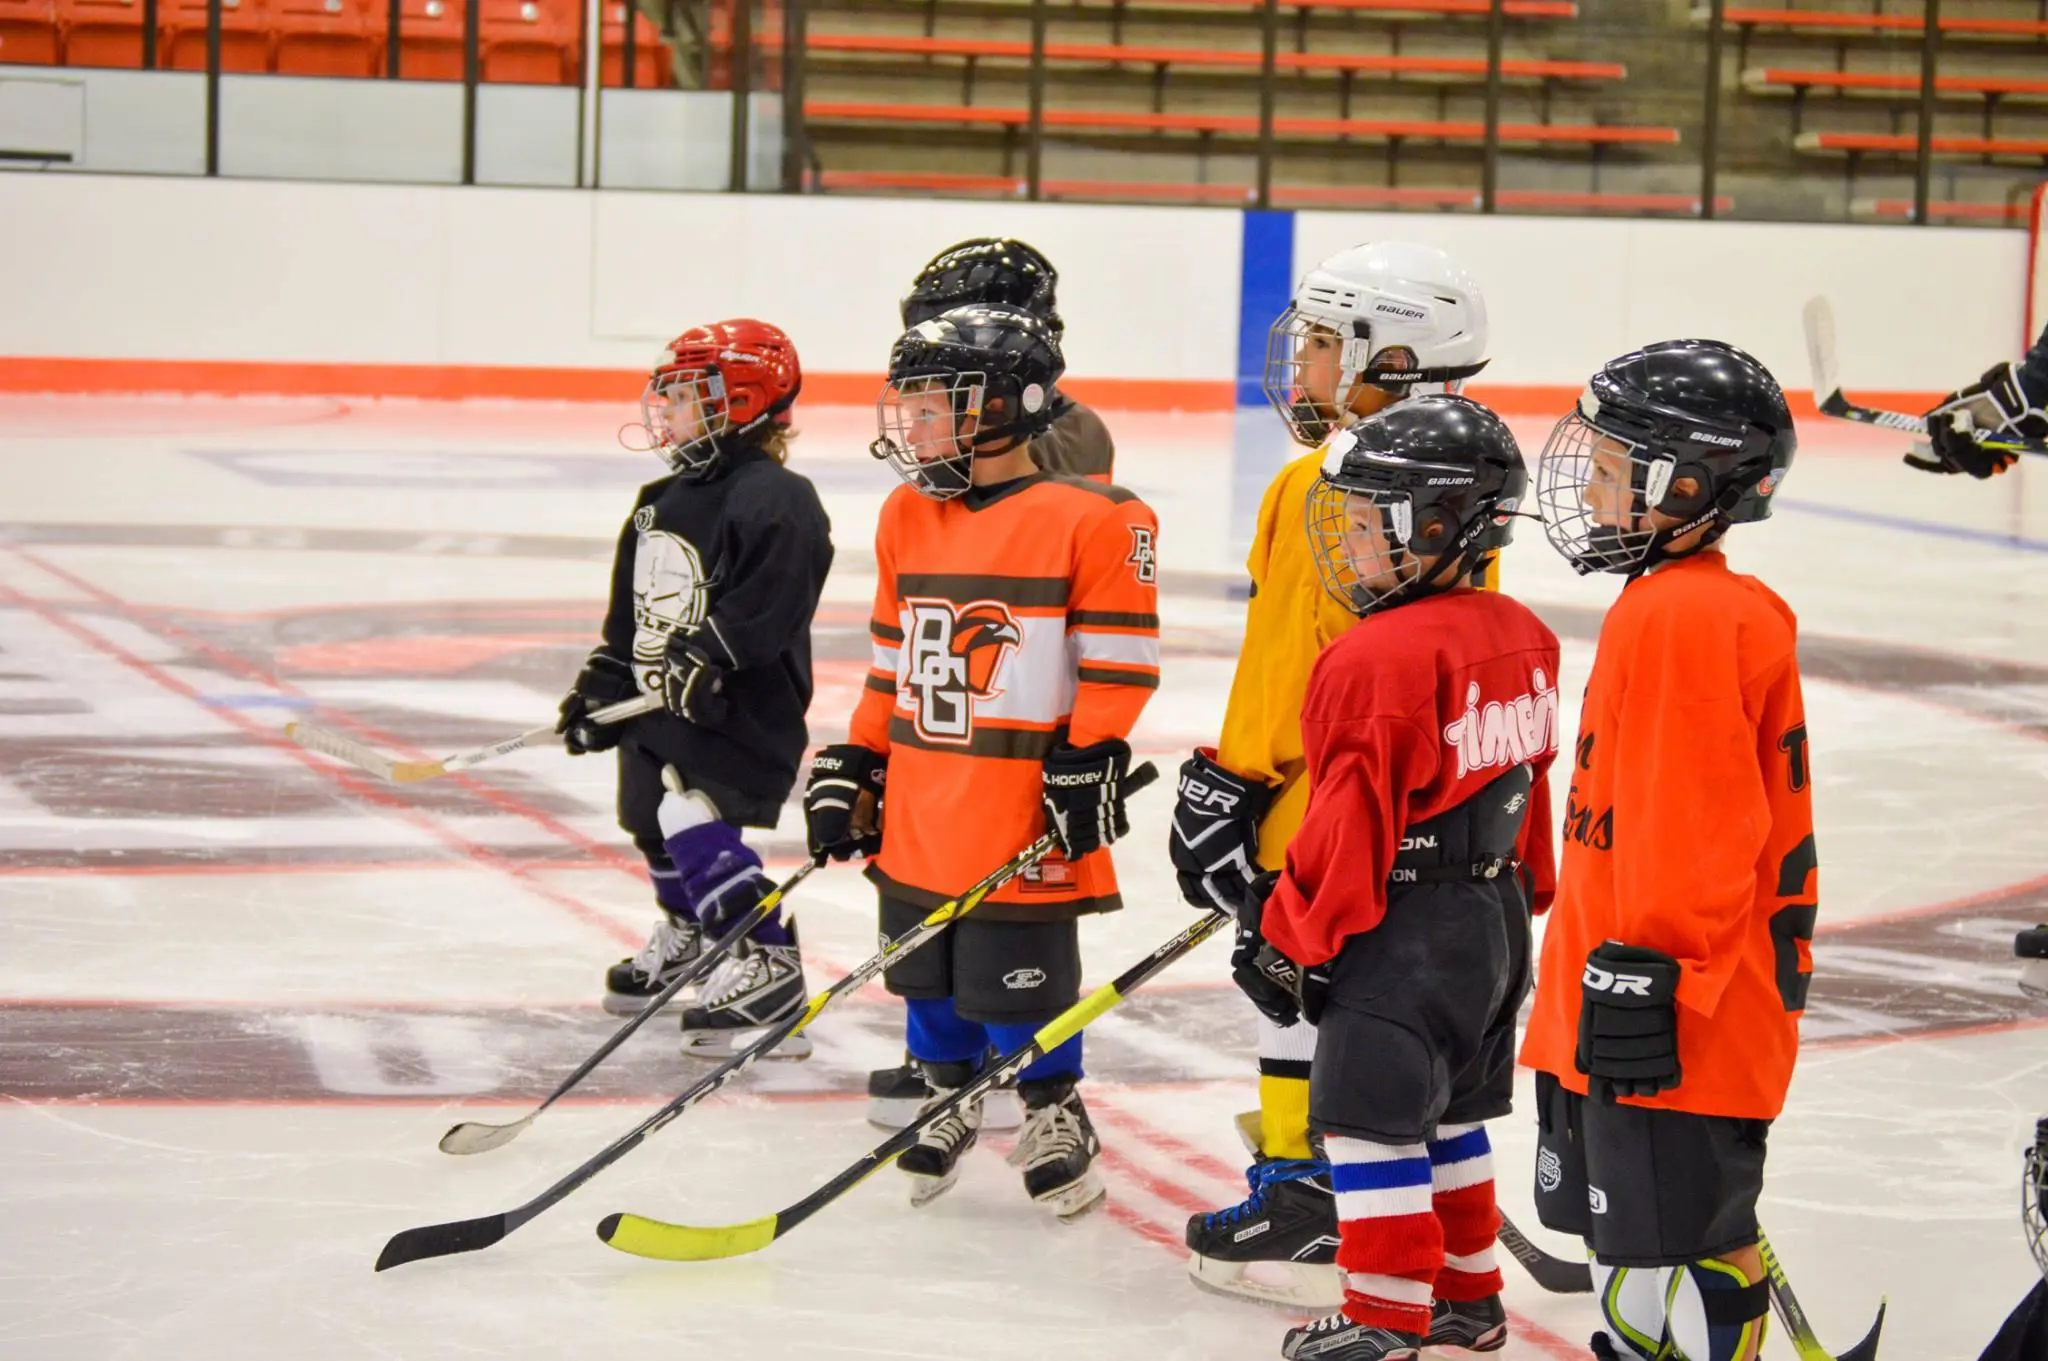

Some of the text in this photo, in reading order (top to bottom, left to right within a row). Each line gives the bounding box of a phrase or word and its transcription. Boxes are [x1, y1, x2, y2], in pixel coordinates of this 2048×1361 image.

[966, 308, 1033, 328] CCM
[1375, 304, 1426, 320] BAUER
[1379, 373, 1423, 381] BAUER
[1688, 431, 1744, 448] BAUER
[1427, 477, 1475, 486] BAUER
[1672, 507, 1720, 538] BAUER
[1051, 771, 1101, 786] HOCKEY
[1235, 1222, 1269, 1241] BAUER
[1323, 1332, 1357, 1350] BAUER
